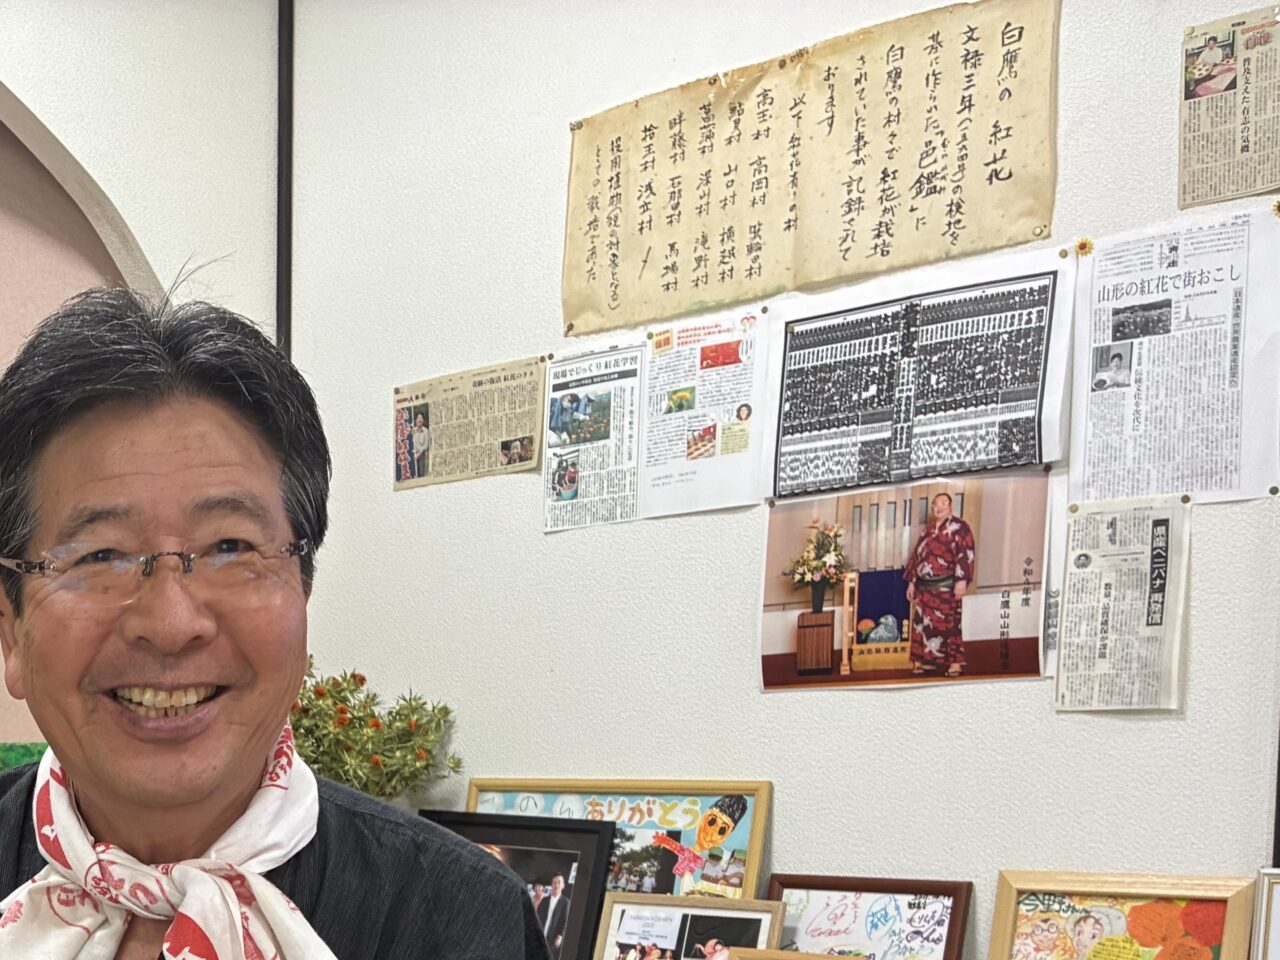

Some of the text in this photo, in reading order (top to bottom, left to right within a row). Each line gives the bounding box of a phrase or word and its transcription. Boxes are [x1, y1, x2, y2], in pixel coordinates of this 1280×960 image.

[984, 119, 1013, 187] 紅花
[720, 163, 738, 211] 山口村
[1097, 264, 1242, 304] 山形の紅花で街おこし
[585, 796, 700, 828] ありがとう
